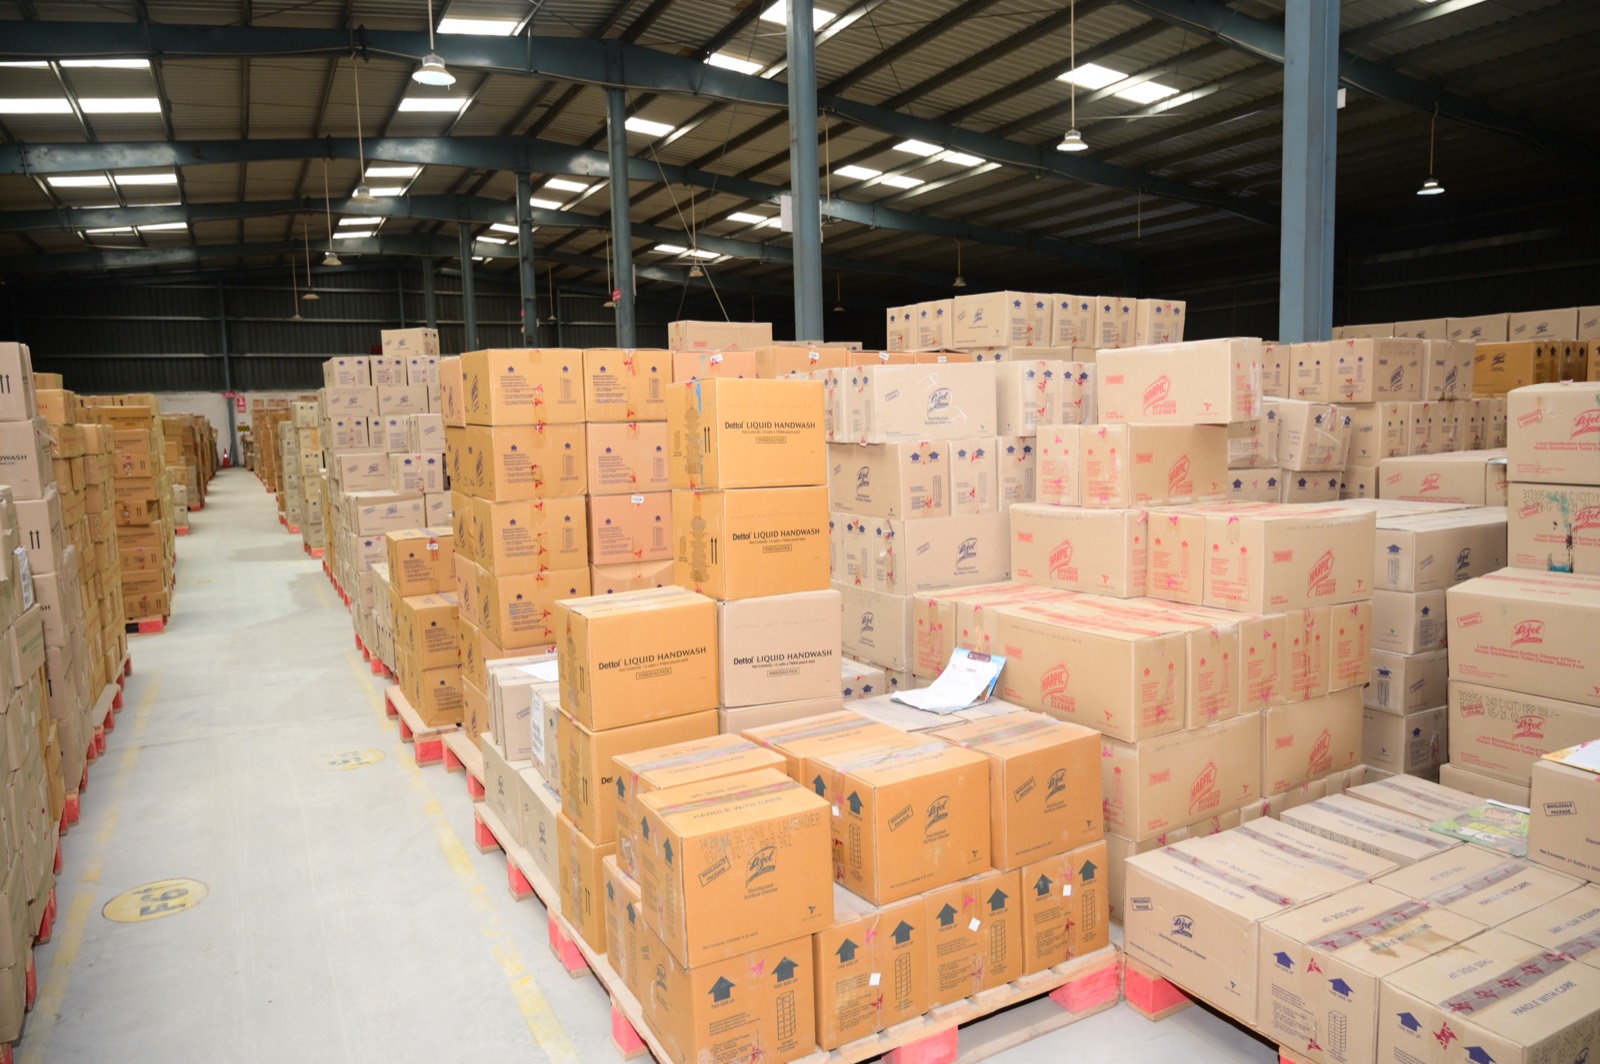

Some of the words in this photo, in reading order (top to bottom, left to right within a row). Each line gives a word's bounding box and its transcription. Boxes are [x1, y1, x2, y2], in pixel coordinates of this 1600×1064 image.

[1144, 381, 1166, 404] HARPIC
[746, 421, 772, 429] LIQUID
[732, 532, 751, 540] Dettol
[754, 531, 778, 539] LIQUID
[781, 528, 820, 537] HANDWASH
[1050, 546, 1069, 567] HARPIC
[1515, 624, 1541, 639] Lizol
[598, 660, 620, 670] Dettol
[624, 655, 655, 666] LIQUID
[658, 646, 706, 660] HANDWASH
[734, 657, 753, 665] Dettol
[757, 654, 784, 663] LIQUID
[787, 650, 832, 660] HANDWASH
[1520, 650, 1538, 658] Surface
[1540, 653, 1560, 661] Cleaner
[1535, 657, 1554, 665] Cleaner
[1042, 670, 1064, 691] HARPIC
[1051, 701, 1076, 714] CLEANER
[1191, 769, 1213, 800] HARPIC
[1174, 917, 1192, 931] Lizol
[1510, 999, 1538, 1016] HANDLE
[1539, 992, 1555, 1003] WITH
[1554, 980, 1577, 996] CARE
